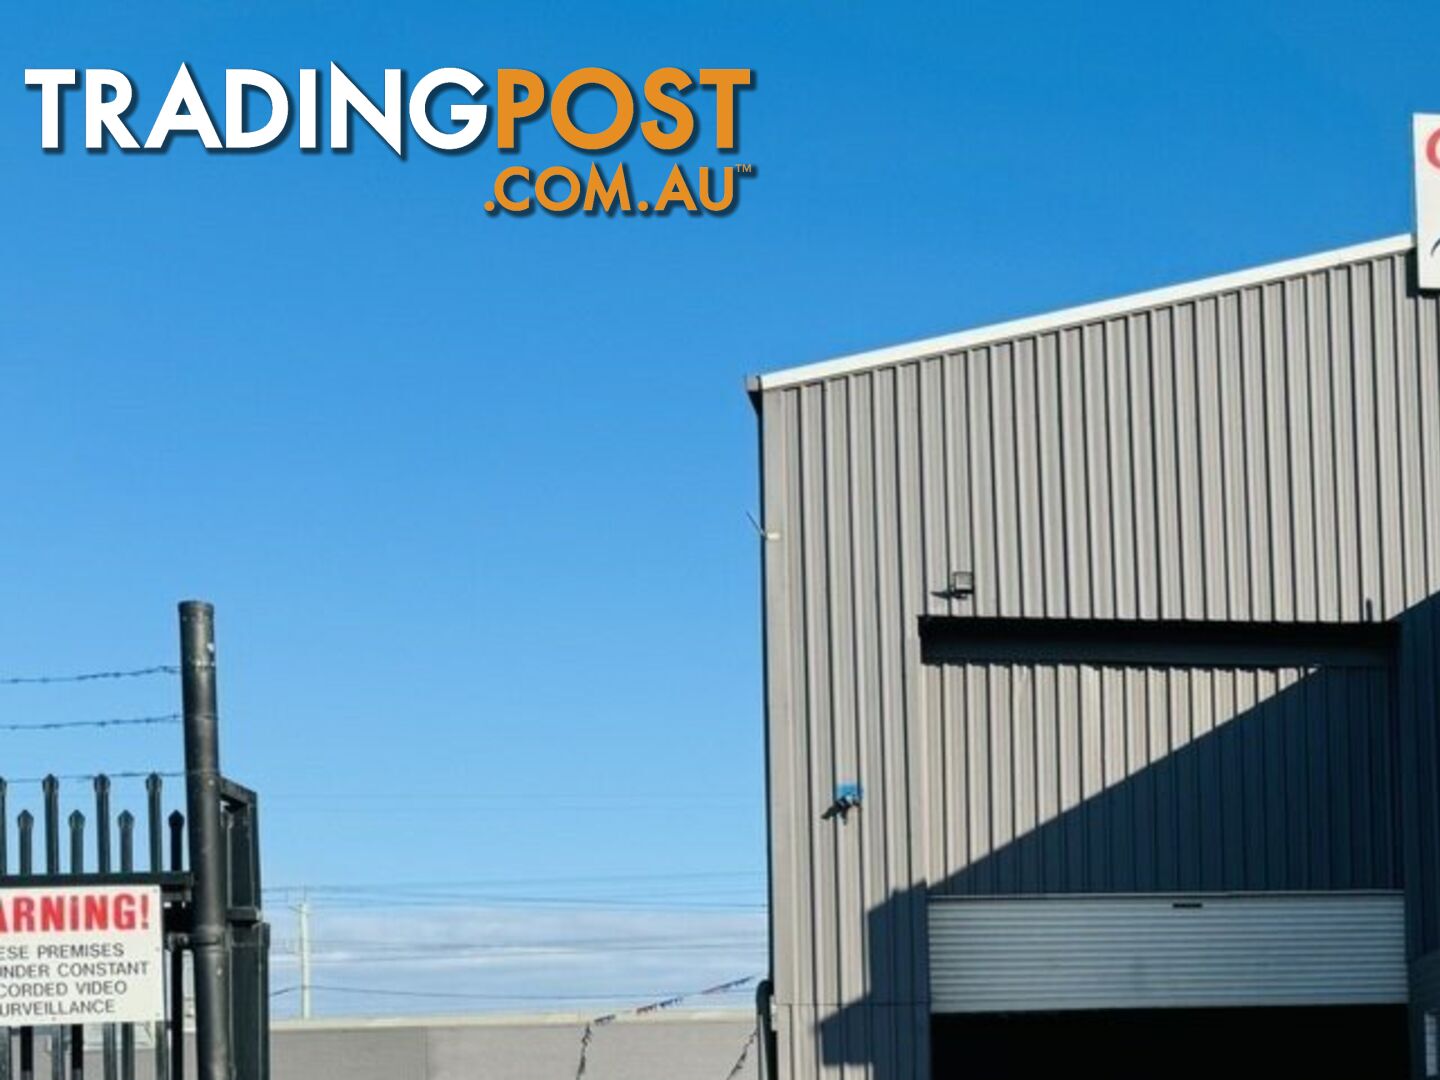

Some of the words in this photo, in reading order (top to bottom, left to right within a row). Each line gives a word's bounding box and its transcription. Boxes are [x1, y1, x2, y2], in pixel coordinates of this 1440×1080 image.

[38, 943, 124, 959] PREMISES
[57, 961, 149, 977] CONSTANT
[75, 981, 128, 996] VIDEO
